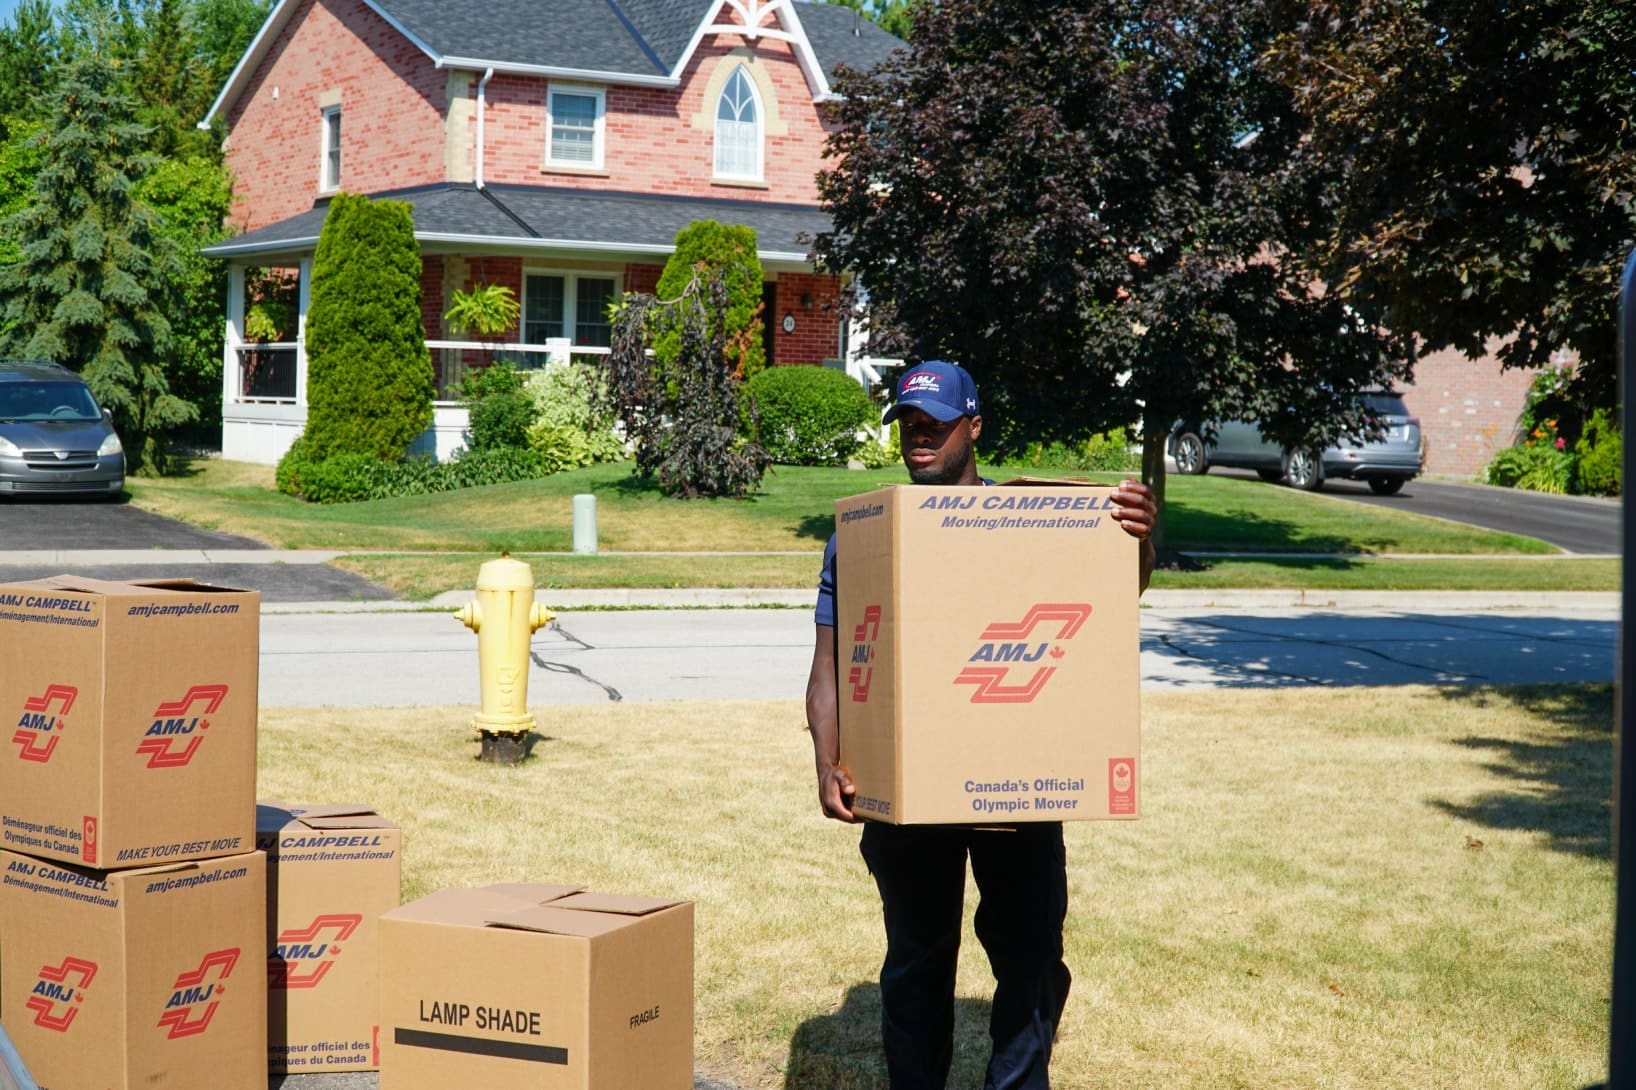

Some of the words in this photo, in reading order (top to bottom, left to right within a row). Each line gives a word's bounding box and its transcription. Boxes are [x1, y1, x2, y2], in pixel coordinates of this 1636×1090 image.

[919, 496, 978, 510] AMJ
[982, 495, 1117, 511] CAMPBELL
[941, 516, 1100, 530] Moving/International
[26, 596, 91, 612] CAMPBELL
[128, 602, 239, 618] amjcampbell.com
[0, 610, 100, 627] éménagement/International
[852, 644, 871, 663] AMJ
[968, 643, 1049, 662] AMJ
[18, 713, 55, 731] AMJ
[145, 717, 199, 736] AMJ
[1034, 778, 1085, 791] Official
[972, 798, 1030, 813] Olympic
[1034, 797, 1078, 810] Mover
[3, 815, 43, 832] Déménageur
[44, 824, 67, 837] officiel
[69, 828, 82, 841] des
[5, 830, 42, 847] Olympiques
[43, 838, 52, 849] du
[53, 840, 79, 854] Canada
[117, 847, 150, 861] MAKE
[150, 844, 181, 857] YOUR
[181, 841, 211, 854] BEST
[210, 837, 241, 851] MOVE
[280, 836, 381, 848] CAMPBELL
[8, 861, 36, 875] AMJ
[38, 867, 108, 891] CAMPBELL
[146, 867, 248, 893] amjcampbell.com
[3, 874, 119, 908] Déménagement/International
[269, 944, 327, 959] AMJ
[32, 980, 74, 1002] AMJ
[165, 984, 215, 1008] AMJ
[420, 1000, 470, 1026] LAMP
[475, 1006, 541, 1035] SHADE
[630, 1005, 660, 1029] FRAGILE
[311, 1041, 348, 1052] officiel
[351, 1040, 370, 1050] des
[310, 1055, 323, 1065] du
[326, 1054, 367, 1064] Canada
